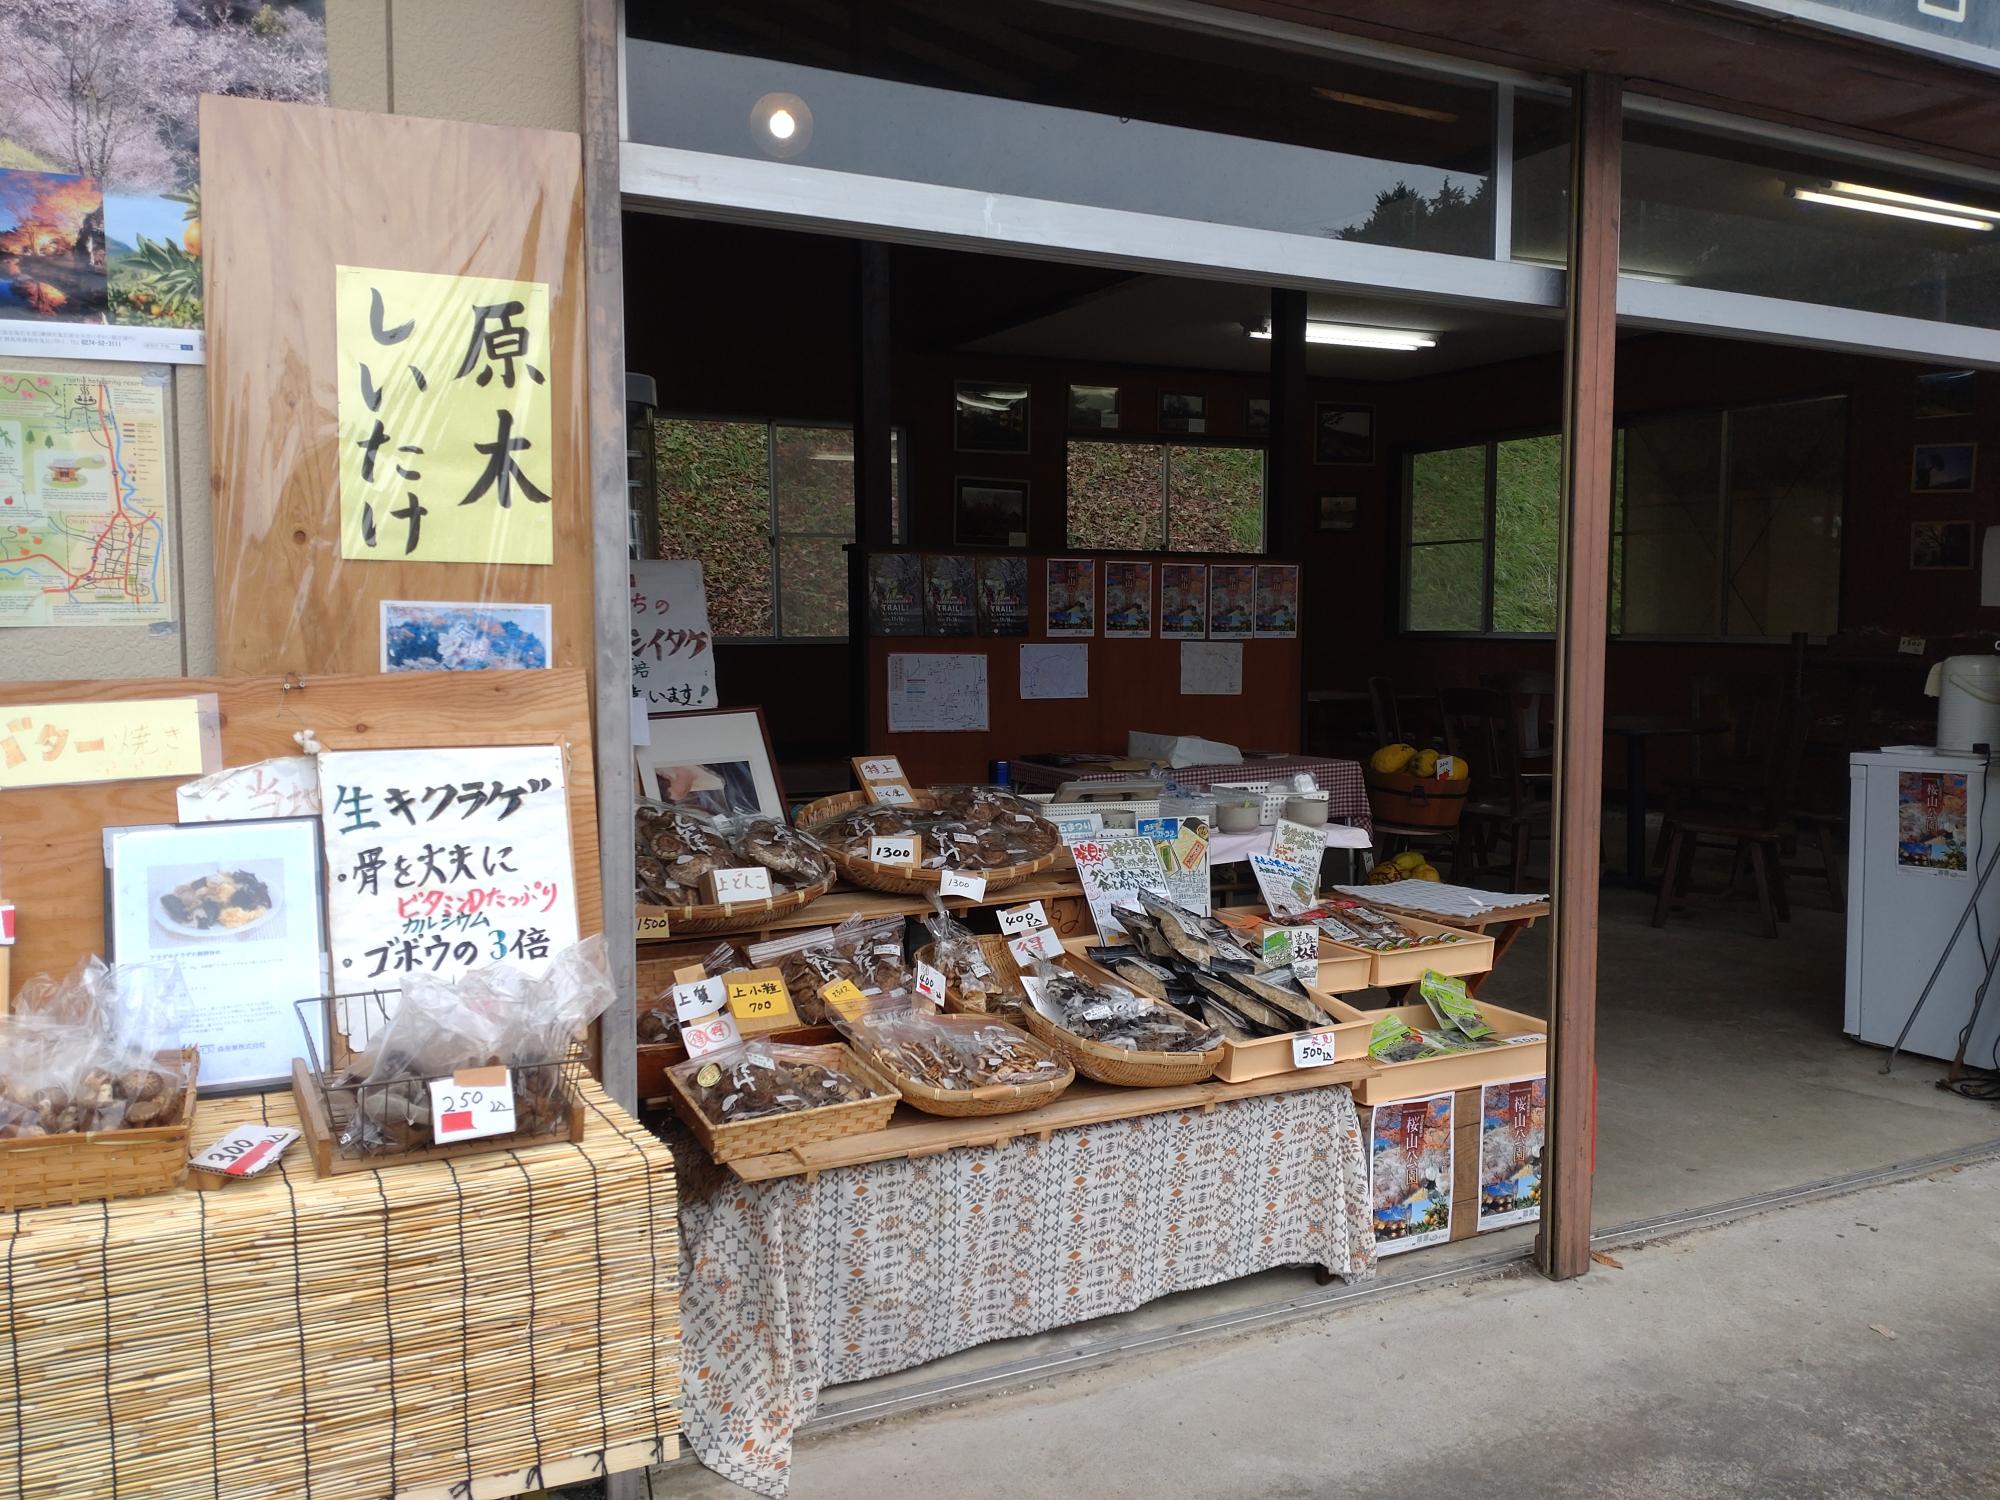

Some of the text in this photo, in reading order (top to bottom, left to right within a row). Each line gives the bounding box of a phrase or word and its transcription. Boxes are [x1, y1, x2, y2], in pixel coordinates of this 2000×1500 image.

[456, 301, 552, 508] 原木
[356, 287, 428, 556] しいたけ
[882, 604, 906, 612] TRAIL
[937, 605, 960, 613] TRAIL
[631, 627, 709, 661] シイタケ
[865, 763, 895, 775] 特上
[333, 778, 552, 835] 生キクラゲ
[1926, 783, 1940, 833] 桜山公園
[876, 846, 911, 858] 1300
[352, 843, 519, 896] 骨を丈夫に
[719, 872, 767, 892] 上どんこ
[948, 877, 970, 889] 1300
[402, 911, 491, 935] カルシウム
[637, 918, 667, 931] 1500
[919, 973, 934, 988] 400
[678, 984, 713, 1007] 上質
[748, 1000, 772, 1013] 700
[442, 1090, 483, 1113] 250
[1513, 1094, 1528, 1162] 桜山公園
[207, 1138, 255, 1163] 300
[1405, 1114, 1420, 1187] 桜山公園
